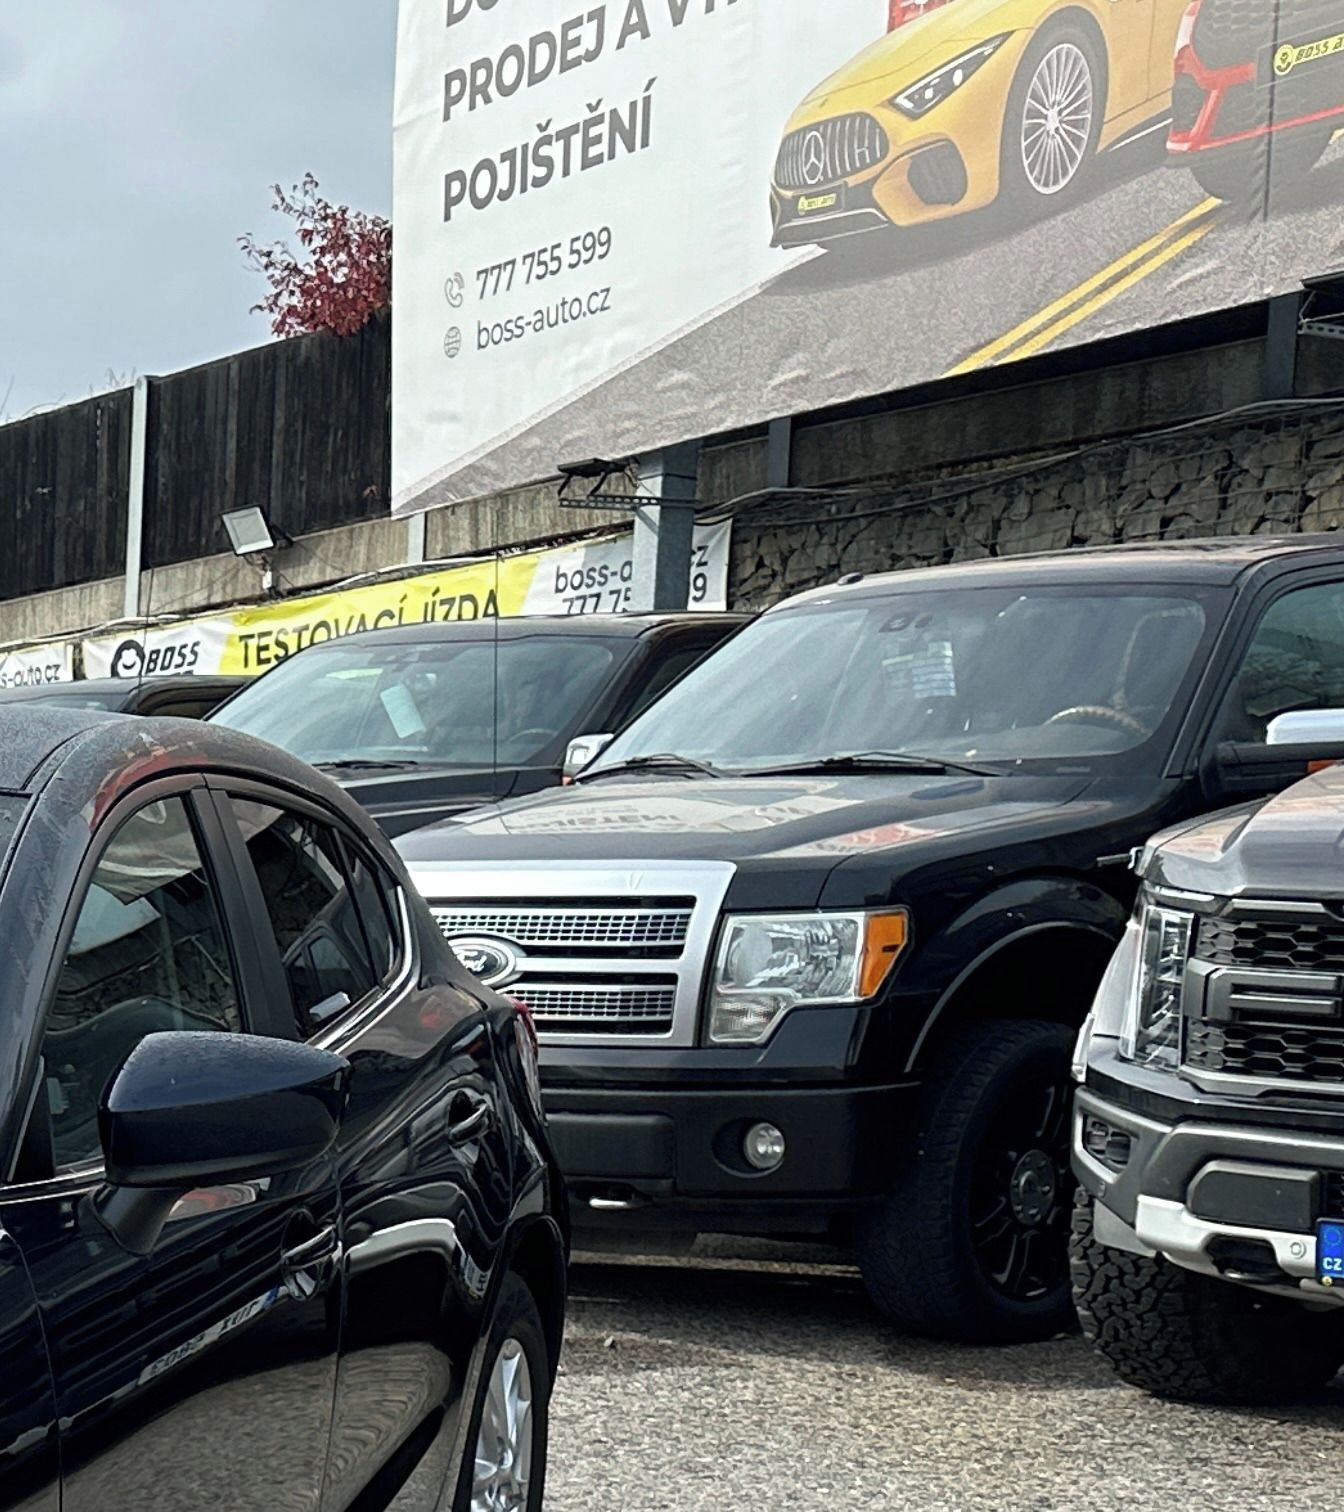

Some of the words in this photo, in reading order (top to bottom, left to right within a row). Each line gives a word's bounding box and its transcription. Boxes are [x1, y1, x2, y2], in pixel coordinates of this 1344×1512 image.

[442, 4, 606, 122] PRODEJ
[615, 0, 651, 50] A
[443, 76, 658, 222] POJIŠTĚNÍ
[476, 258, 517, 300] 777
[522, 242, 563, 285] 755
[568, 226, 612, 269] 599
[477, 287, 611, 350] boss-auto.cz
[145, 640, 201, 675] BOSS
[1322, 1256, 1343, 1271] CZ
